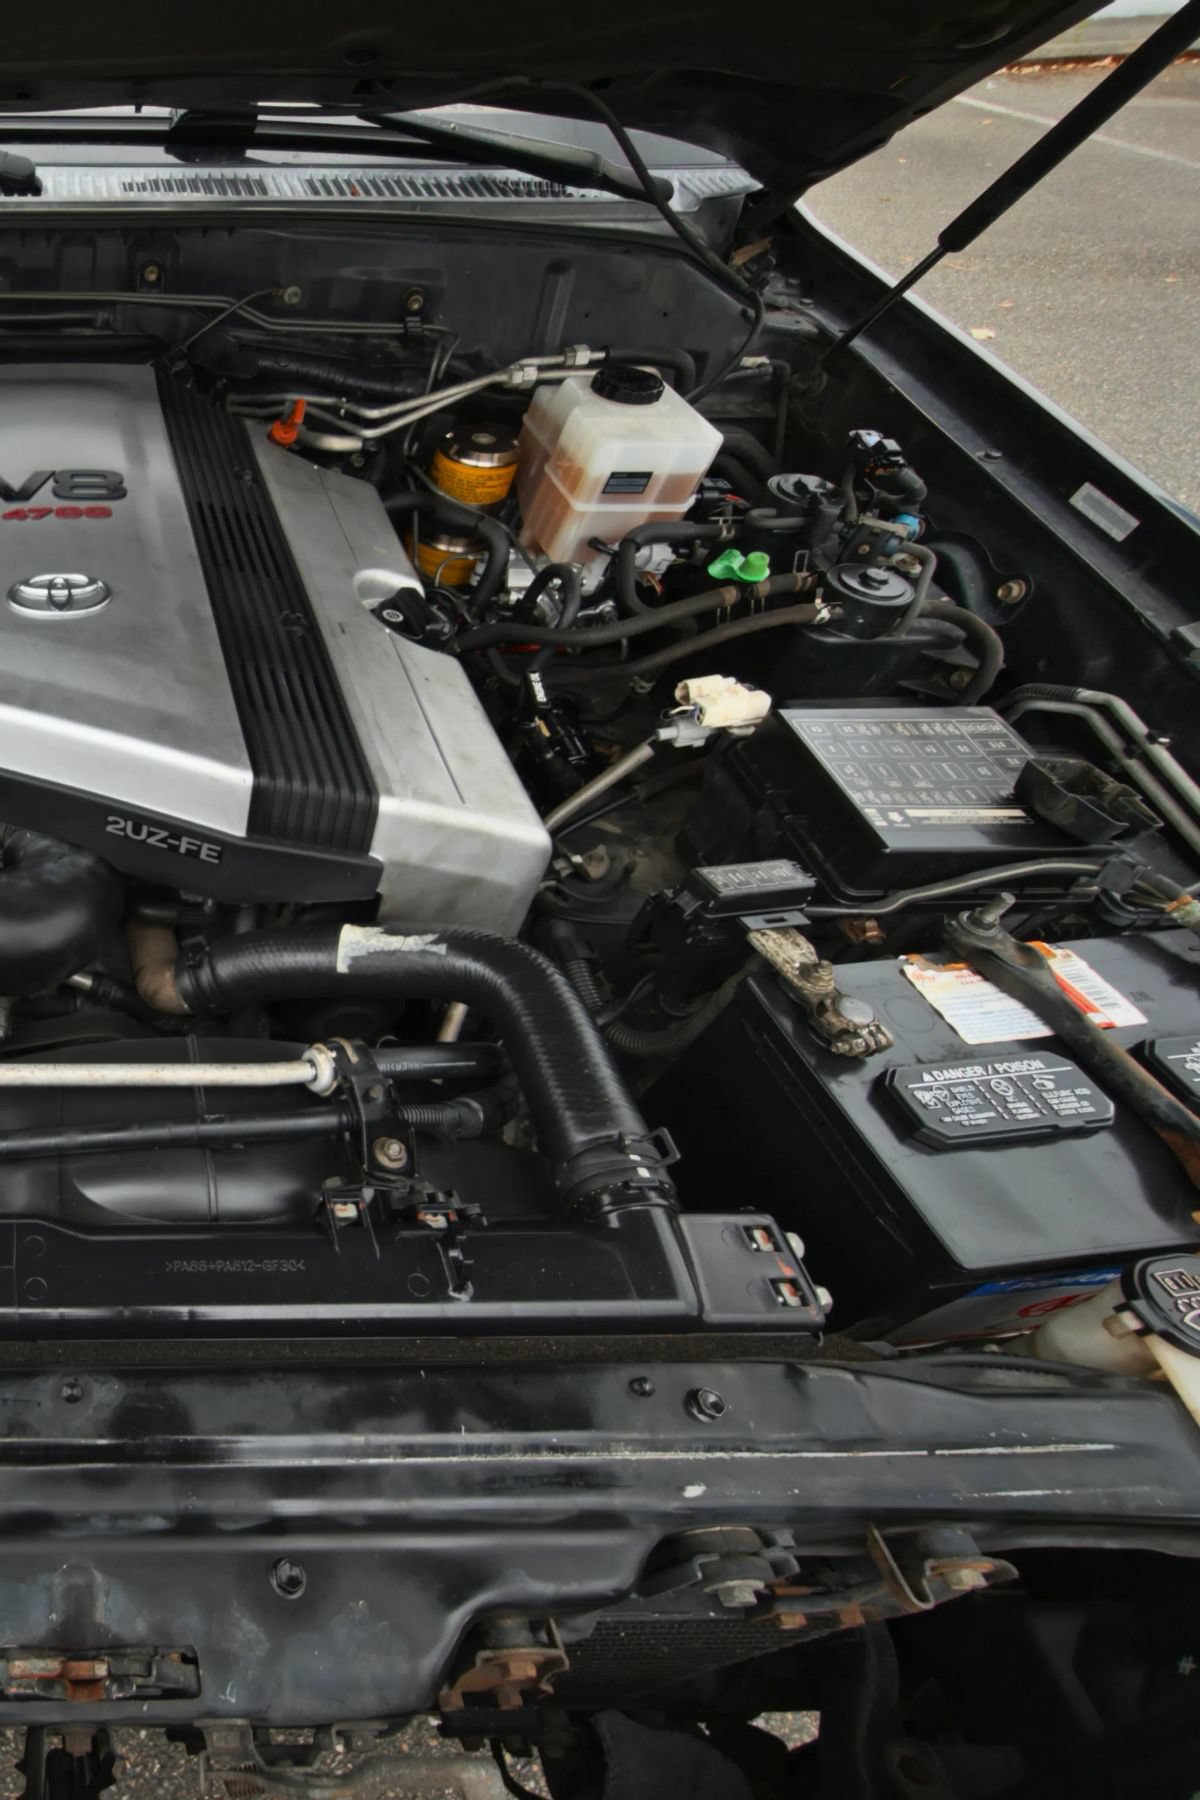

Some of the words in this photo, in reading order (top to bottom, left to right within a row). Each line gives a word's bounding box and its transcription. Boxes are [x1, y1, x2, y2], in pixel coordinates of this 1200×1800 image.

[1, 505, 113, 521] 4700
[105, 815, 222, 864] 2UZ-FE
[932, 1064, 987, 1082] DANGER
[994, 1059, 1046, 1074] POISON
